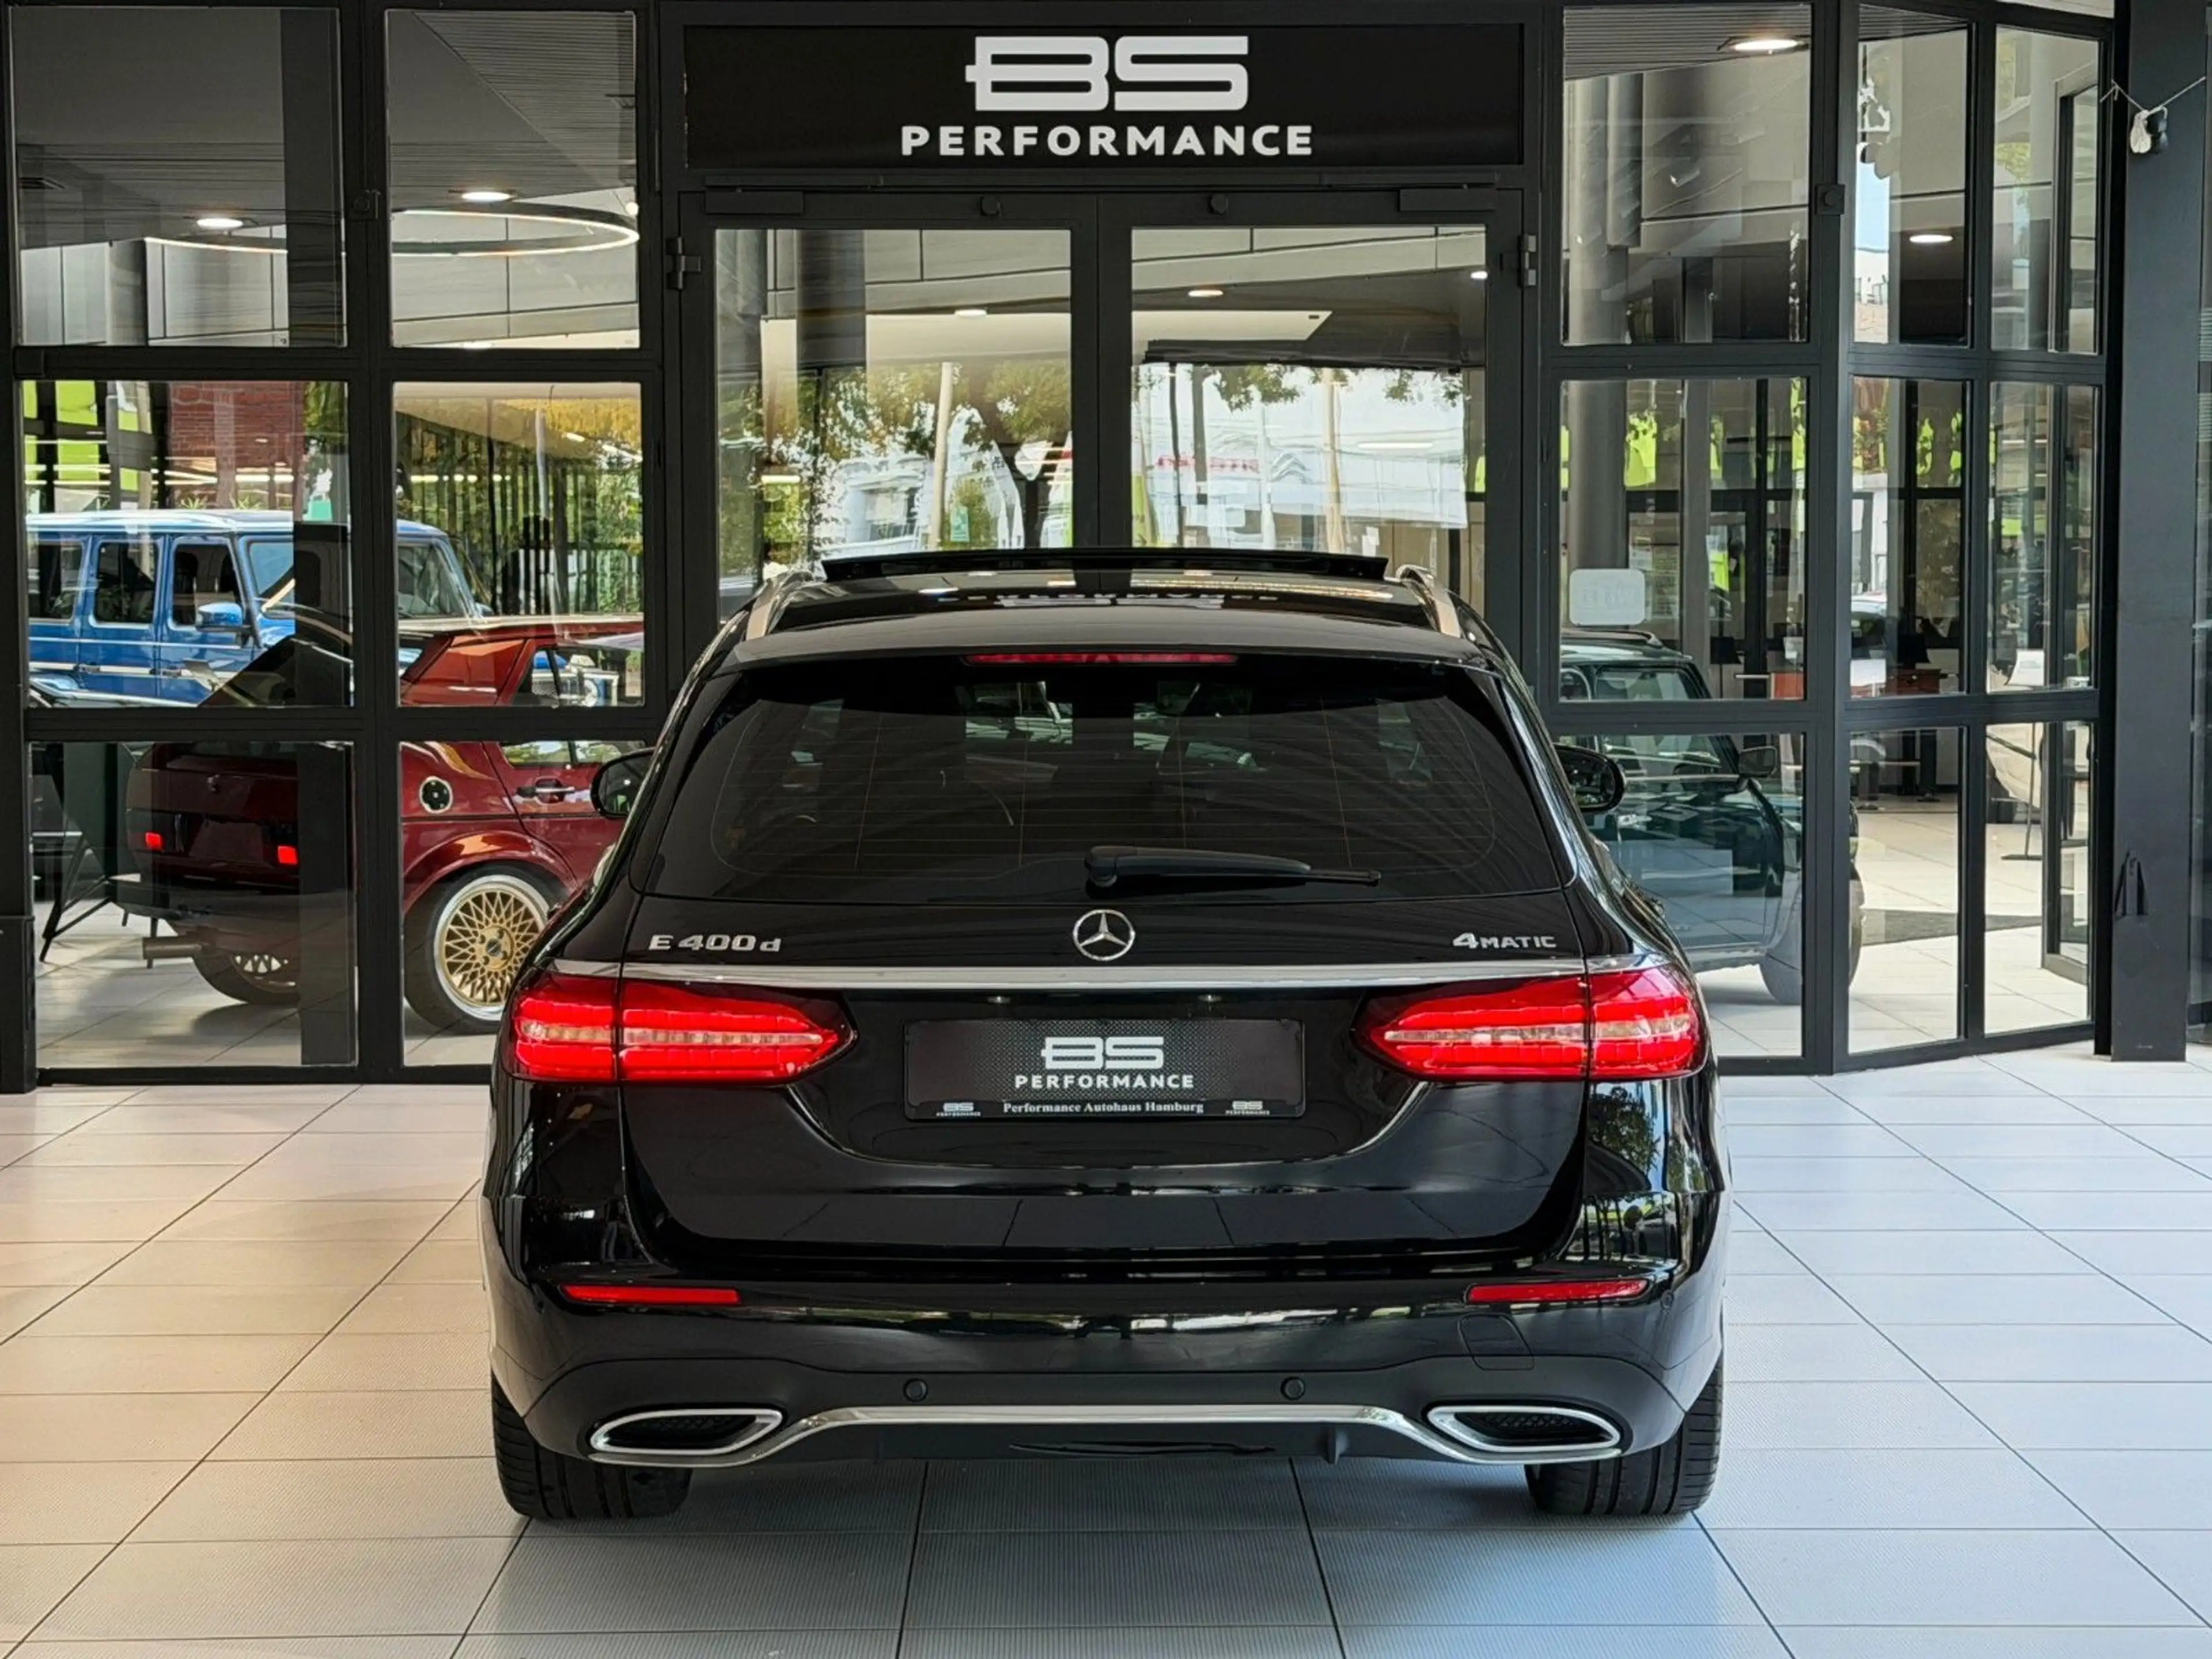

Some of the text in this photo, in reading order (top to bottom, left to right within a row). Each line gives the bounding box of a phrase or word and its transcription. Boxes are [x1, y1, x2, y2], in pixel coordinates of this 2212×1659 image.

[965, 36, 1249, 111] BS
[902, 125, 1312, 156] PERFORMANCE
[1453, 933, 1557, 949] 4MATIC
[1041, 1036, 1164, 1070] BS
[1014, 1074, 1194, 1089] PERFORMANCE
[1003, 1101, 1204, 1114] Performance Autohaus Hamburg
